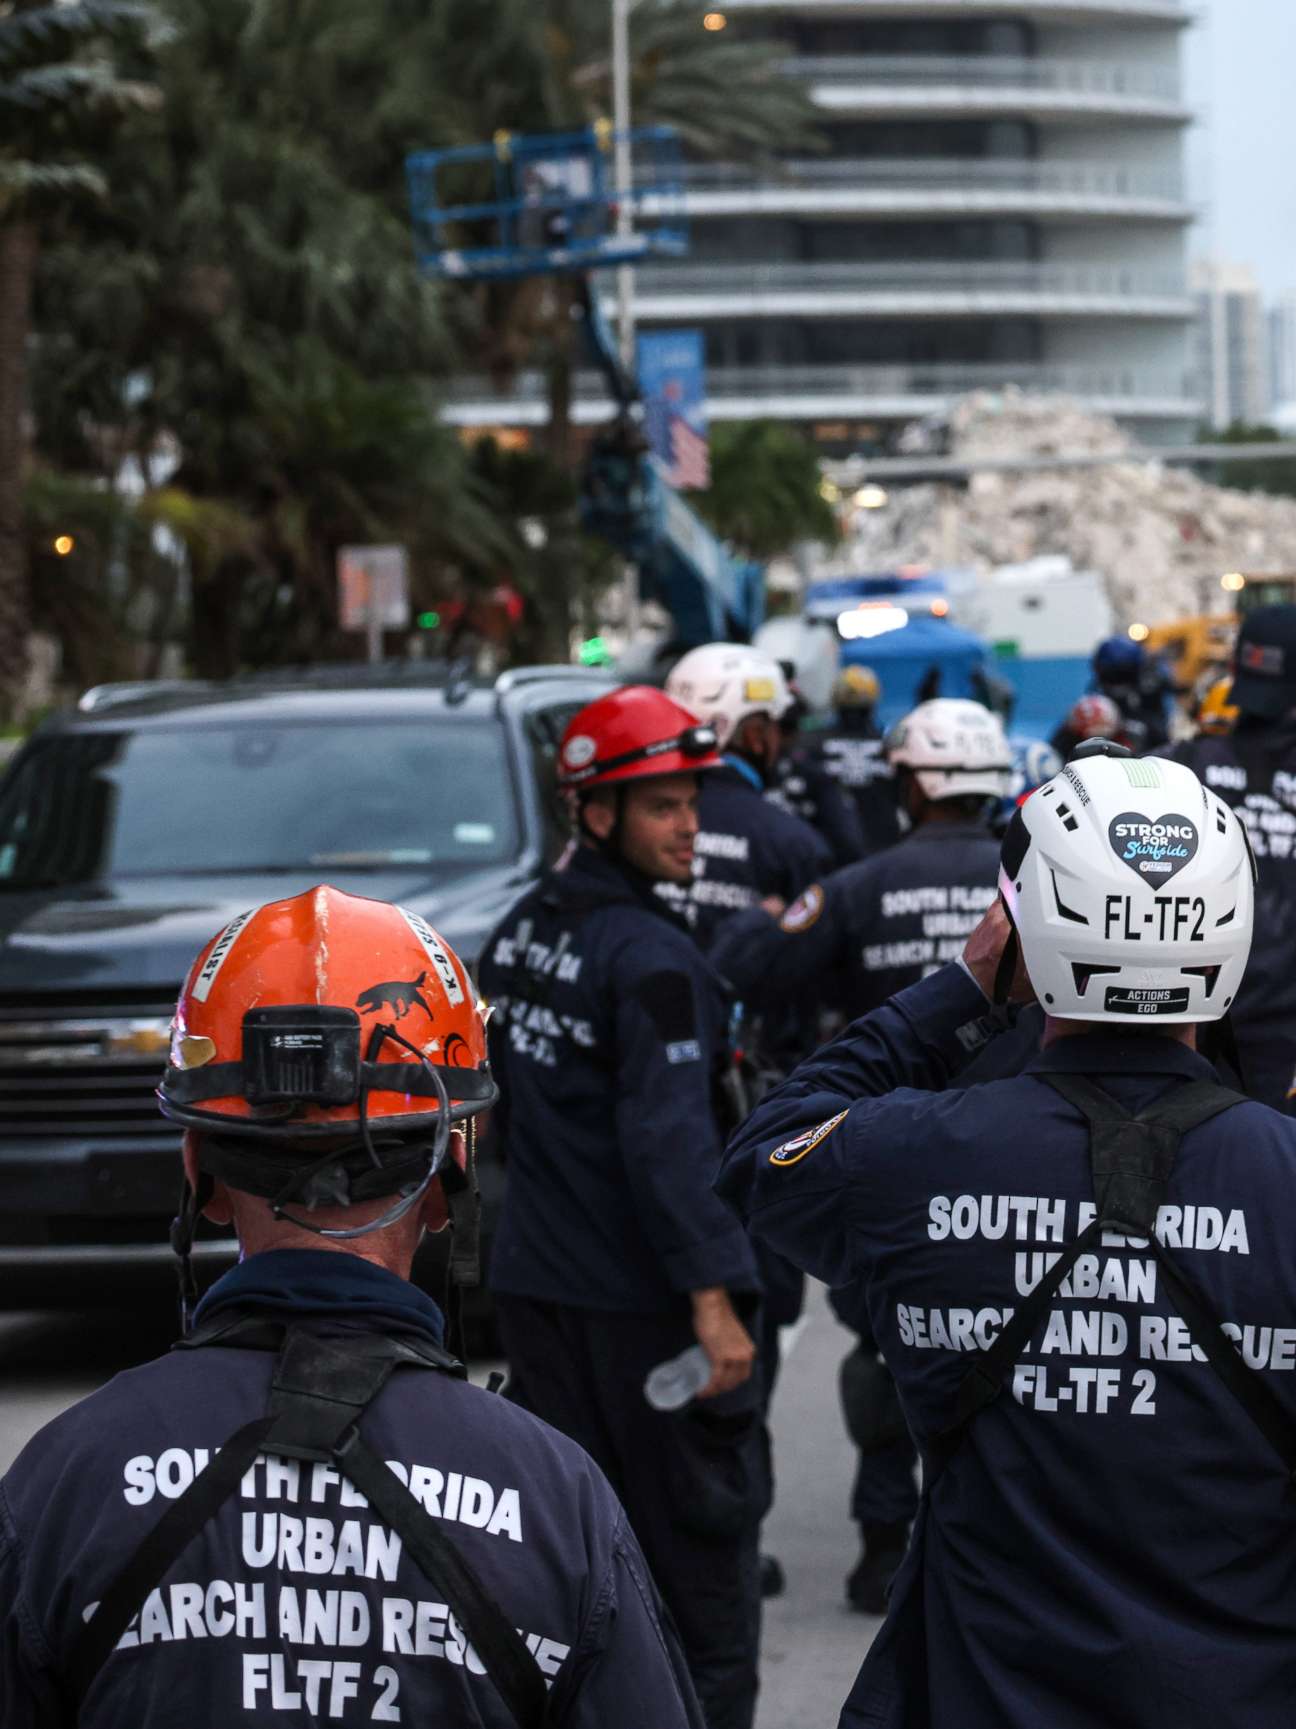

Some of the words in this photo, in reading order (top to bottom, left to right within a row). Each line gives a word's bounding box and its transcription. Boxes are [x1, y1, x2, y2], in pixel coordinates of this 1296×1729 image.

[1115, 823, 1193, 840] STRONG
[1123, 841, 1189, 860] Surfside
[1142, 836, 1168, 846] FOR
[1104, 895, 1206, 941] FL-TF2
[1127, 990, 1171, 1002] ACTIONS
[1137, 1003, 1158, 1014] EGO
[927, 1194, 1066, 1243] SOUTH
[1041, 1309, 1129, 1356] AND
[1011, 1363, 1121, 1414] FL-TF
[1130, 1368, 1156, 1415] 2
[241, 1511, 402, 1582] URBAN
[278, 1585, 372, 1647] AND
[371, 1664, 401, 1723] 2
